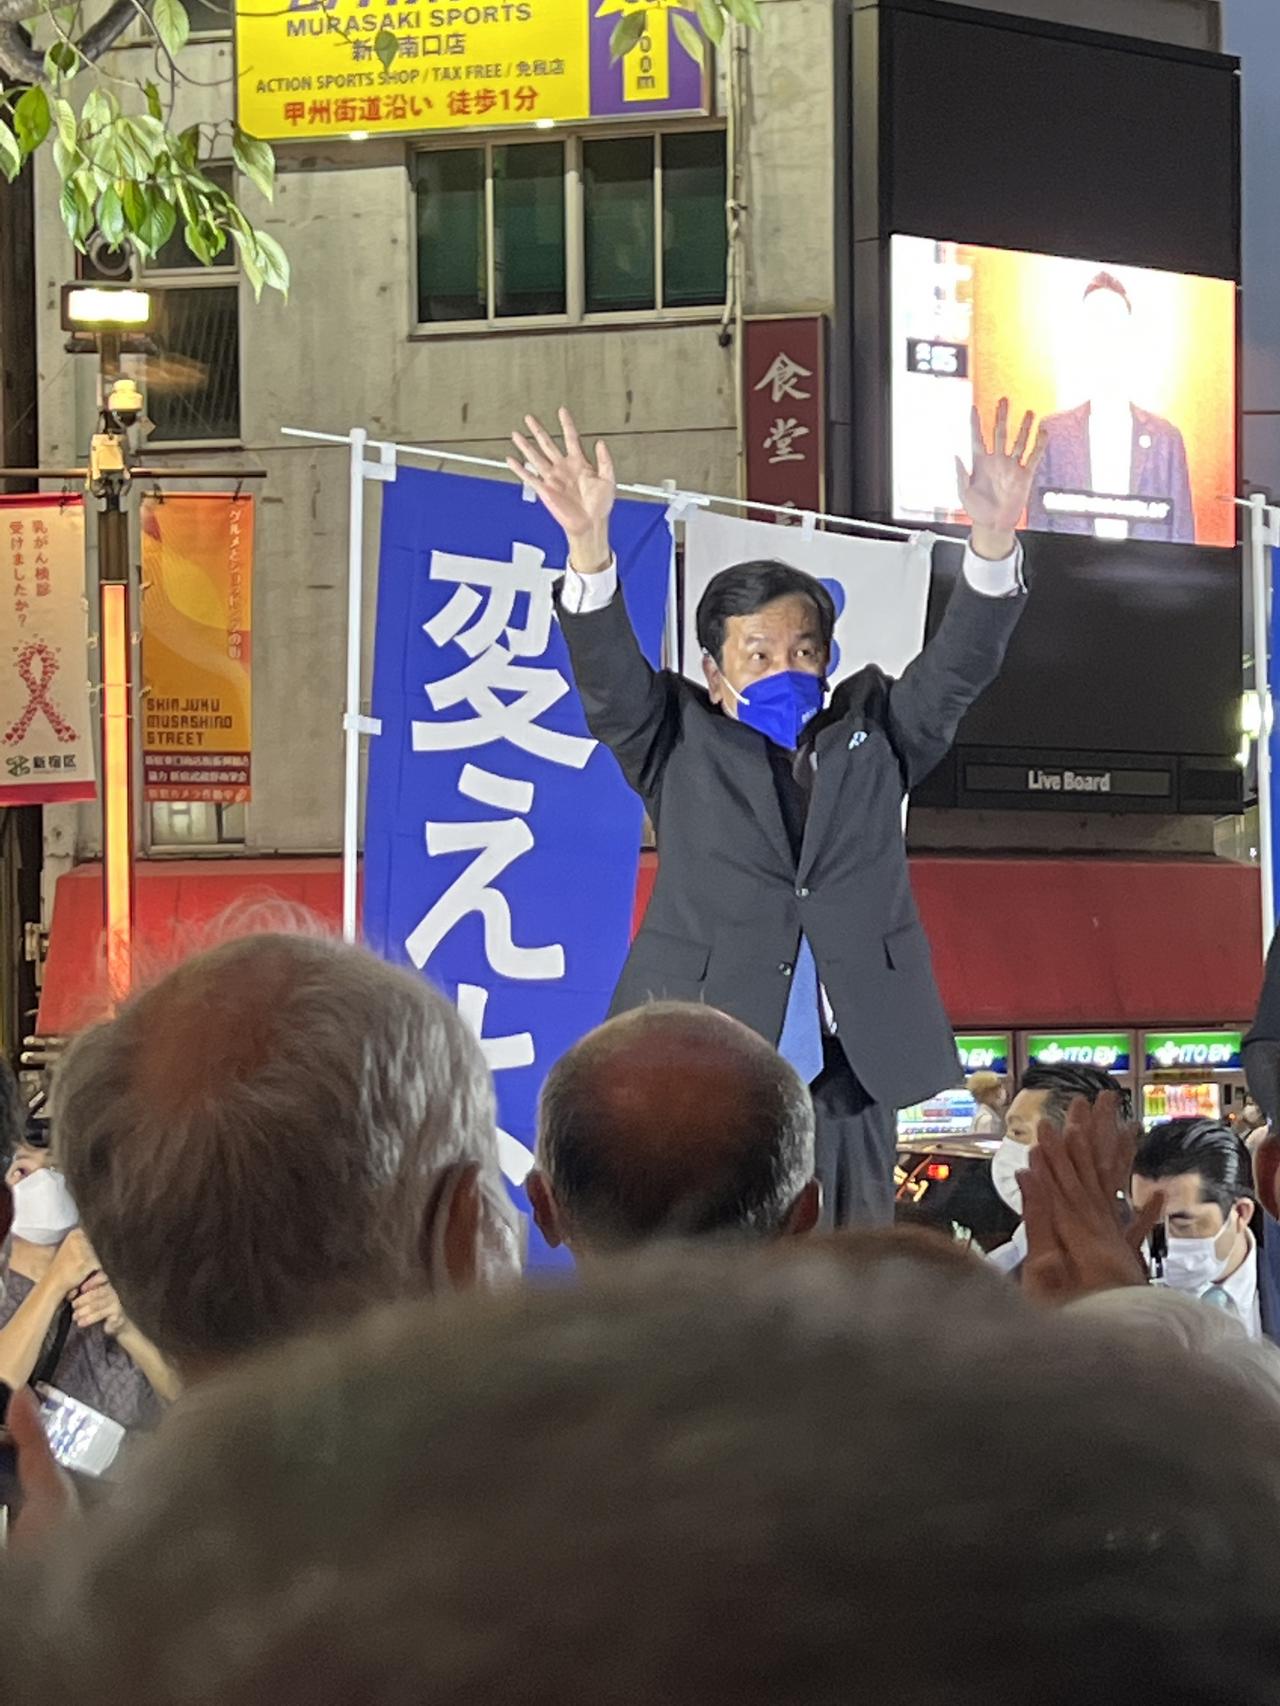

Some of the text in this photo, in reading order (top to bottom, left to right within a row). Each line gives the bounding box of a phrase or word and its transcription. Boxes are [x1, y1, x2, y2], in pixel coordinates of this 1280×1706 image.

[286, 11, 420, 36] MURASAKI
[430, 3, 532, 27] SPORTS
[352, 33, 466, 61] 新南口店
[256, 76, 312, 93] ACTION
[317, 72, 374, 90] SPORTS
[378, 69, 419, 86] SHOP
[432, 66, 462, 82] TAX
[465, 64, 502, 80] FREE
[284, 85, 538, 126] 甲州街道沿い 徒歩1分
[32, 520, 51, 597] 乳がん検診
[147, 698, 220, 712] SHINJUKU
[147, 714, 233, 729] MUSASHINO
[147, 731, 204, 745] STREET
[33, 754, 76, 769] 新宿区
[1028, 770, 1111, 791] Live Board
[1179, 1044, 1208, 1063] ITO
